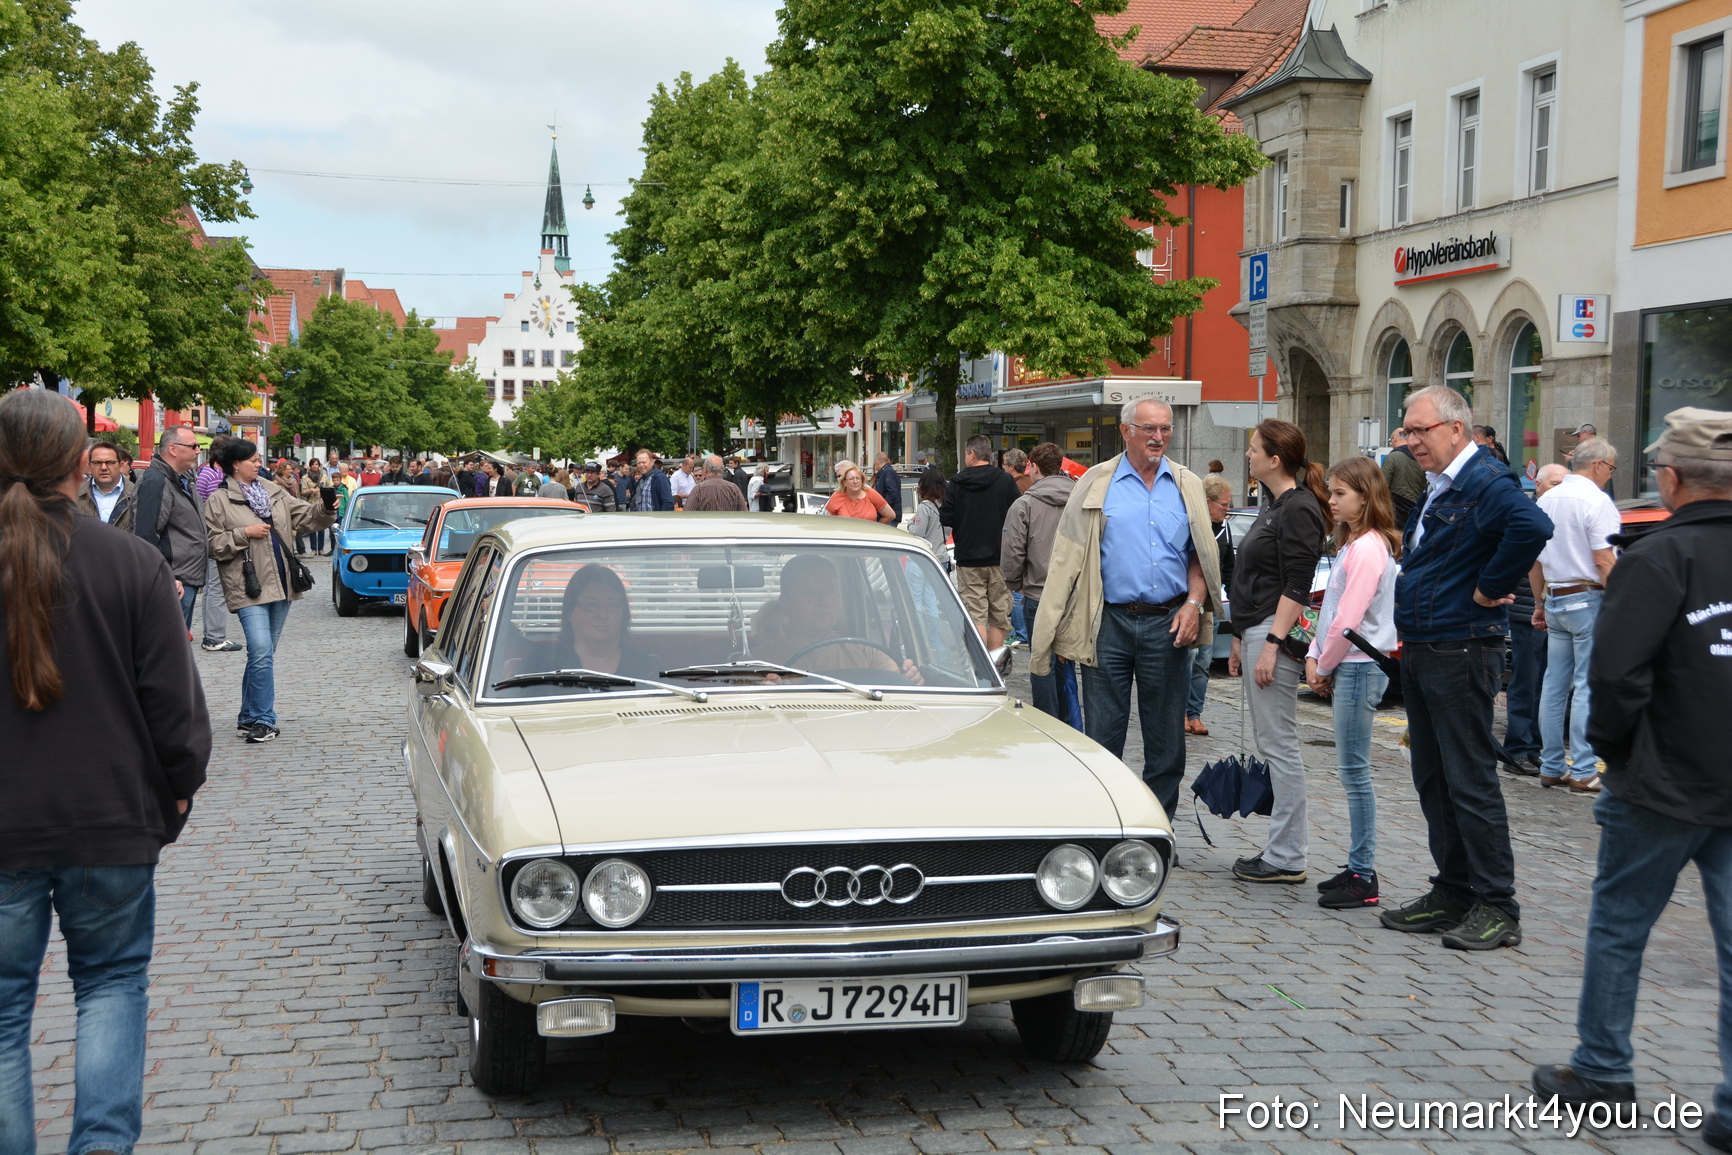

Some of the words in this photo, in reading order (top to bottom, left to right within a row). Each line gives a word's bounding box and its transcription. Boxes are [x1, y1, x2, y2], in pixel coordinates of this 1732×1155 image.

[1406, 230, 1497, 276] HypoVereinsbank
[1253, 260, 1264, 295] P
[1686, 601, 1732, 625] Münchsho
[744, 1010, 753, 1021] D
[762, 989, 784, 1023] R
